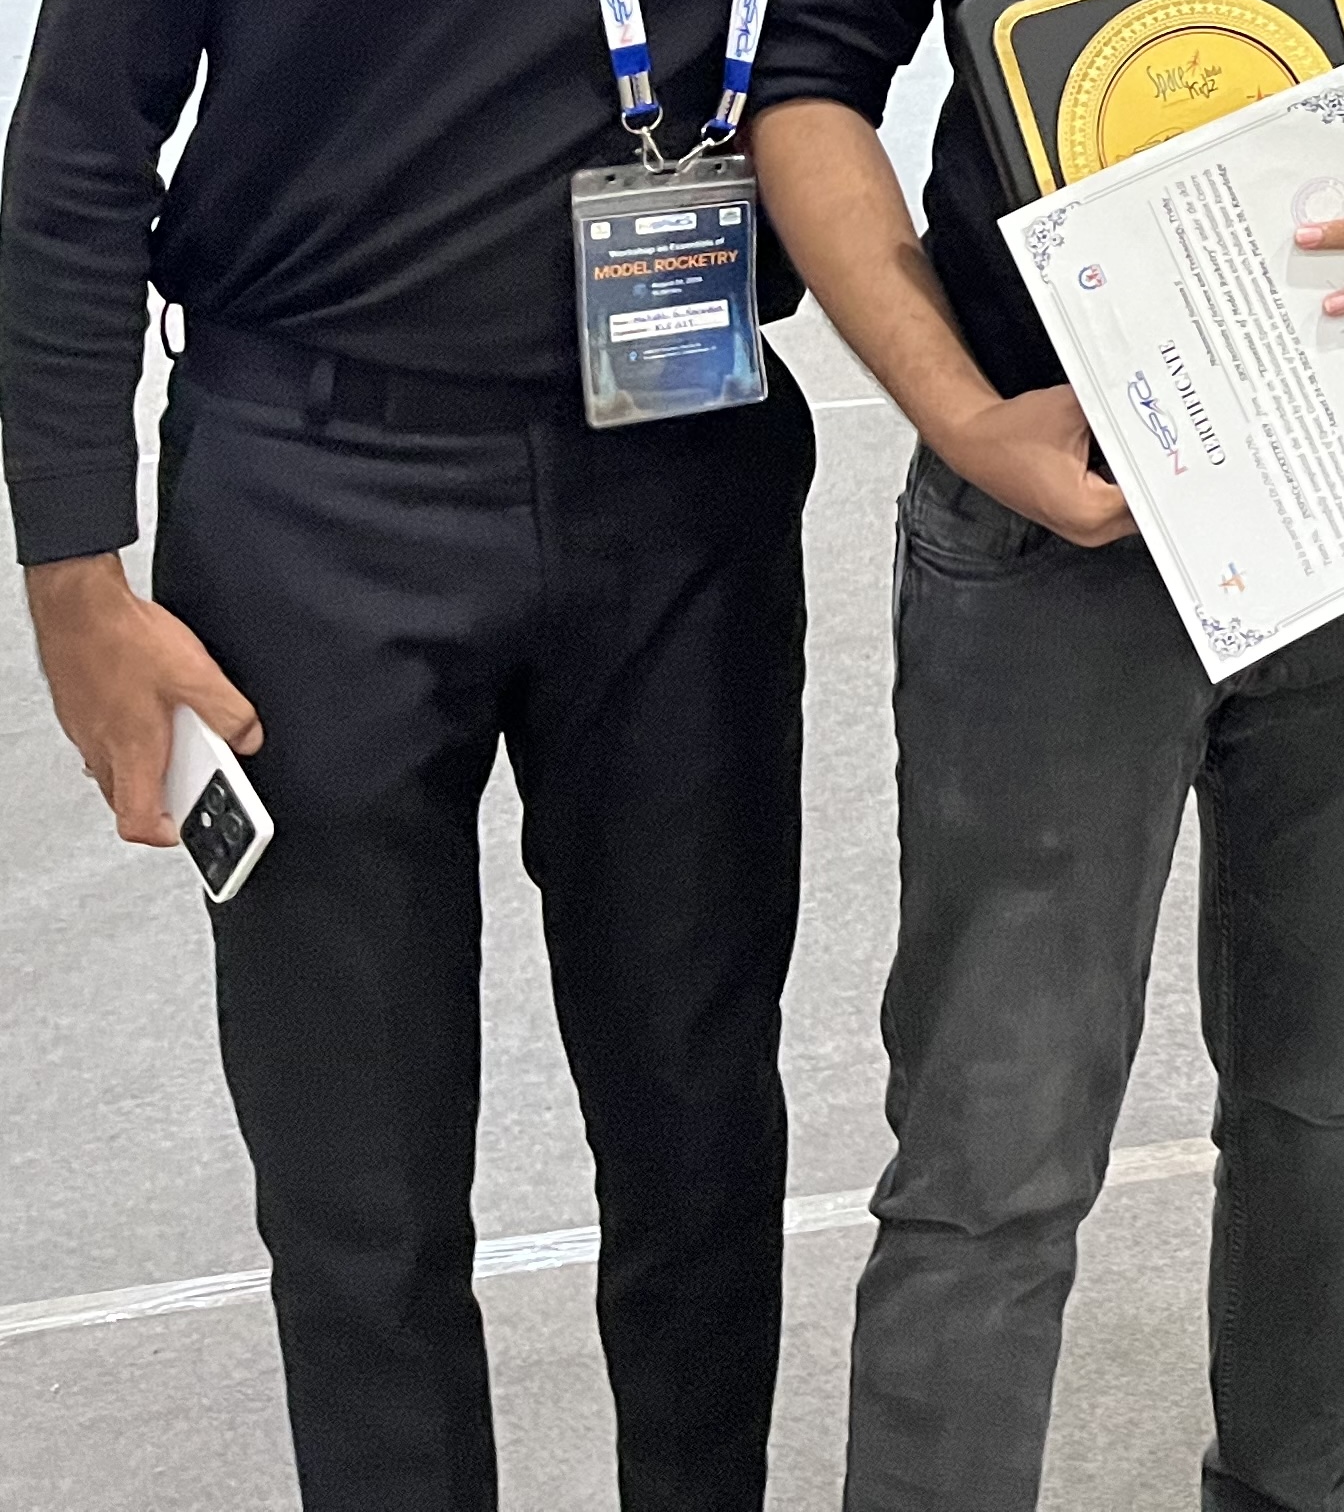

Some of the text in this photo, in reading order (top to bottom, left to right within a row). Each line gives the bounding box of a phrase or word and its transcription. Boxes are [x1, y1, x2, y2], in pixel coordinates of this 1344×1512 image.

[1146, 65, 1187, 101] Space
[594, 249, 739, 280] MODEL ROCKETRY
[1159, 339, 1226, 465] CERTIFICATE
